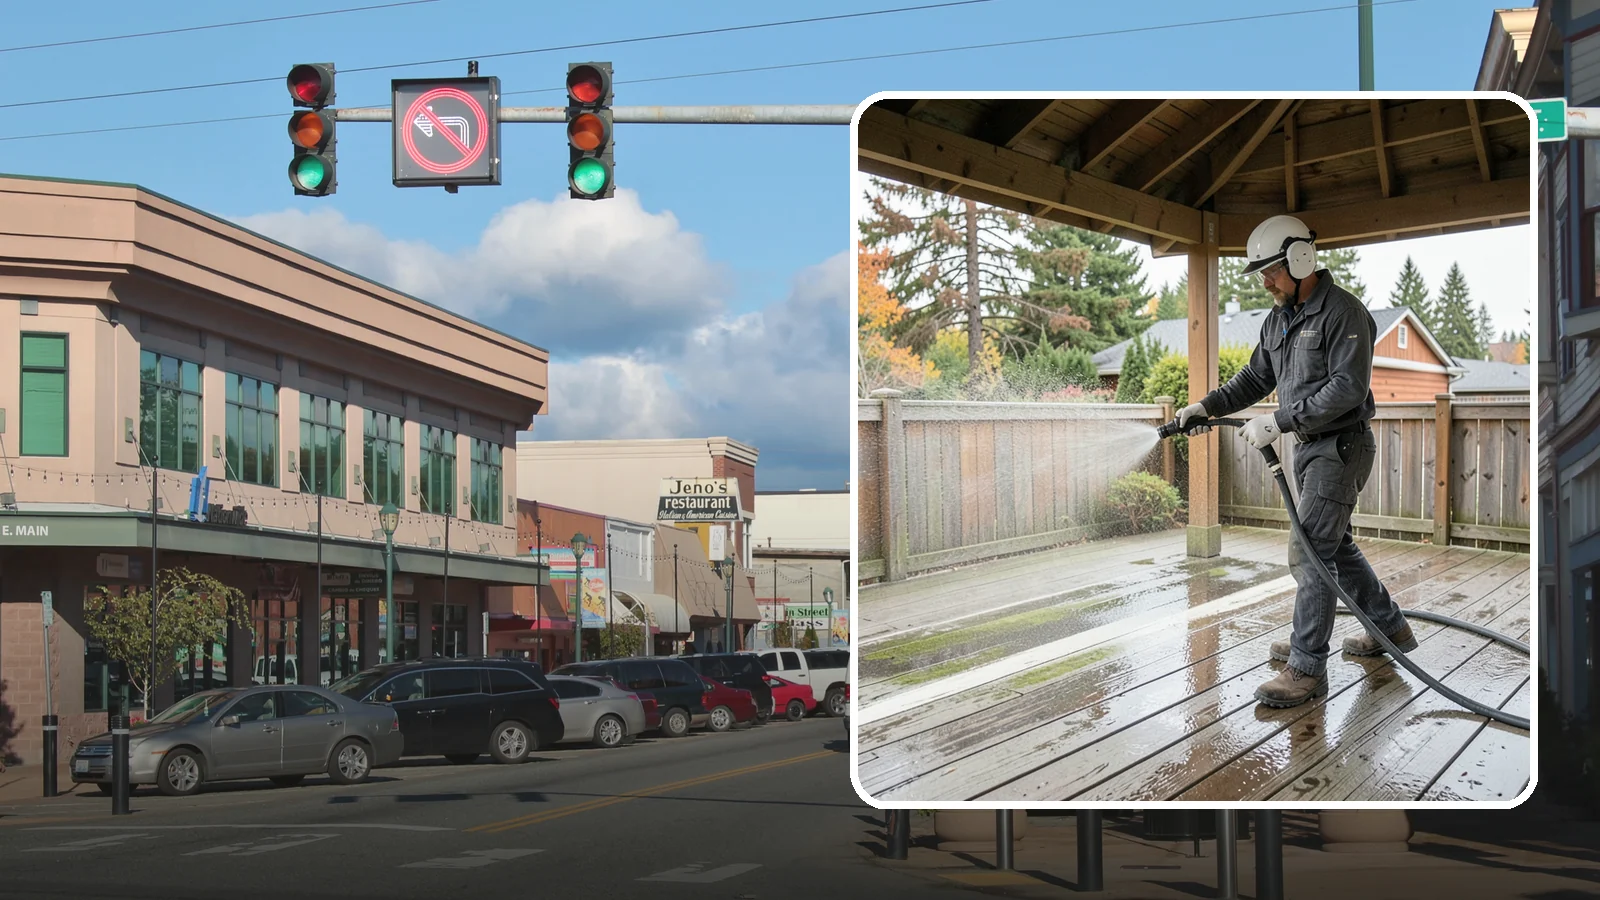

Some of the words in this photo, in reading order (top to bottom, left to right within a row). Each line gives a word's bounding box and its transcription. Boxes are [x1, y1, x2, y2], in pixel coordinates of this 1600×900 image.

[670, 480, 728, 495] Jeno's
[665, 496, 731, 509] restaurant
[658, 510, 682, 519] Italian
[686, 510, 714, 519] American
[715, 510, 737, 519] Cuisine
[2, 525, 13, 536] E.
[15, 525, 49, 536] MAIN
[797, 607, 829, 617] Street
[790, 619, 824, 627] lass
